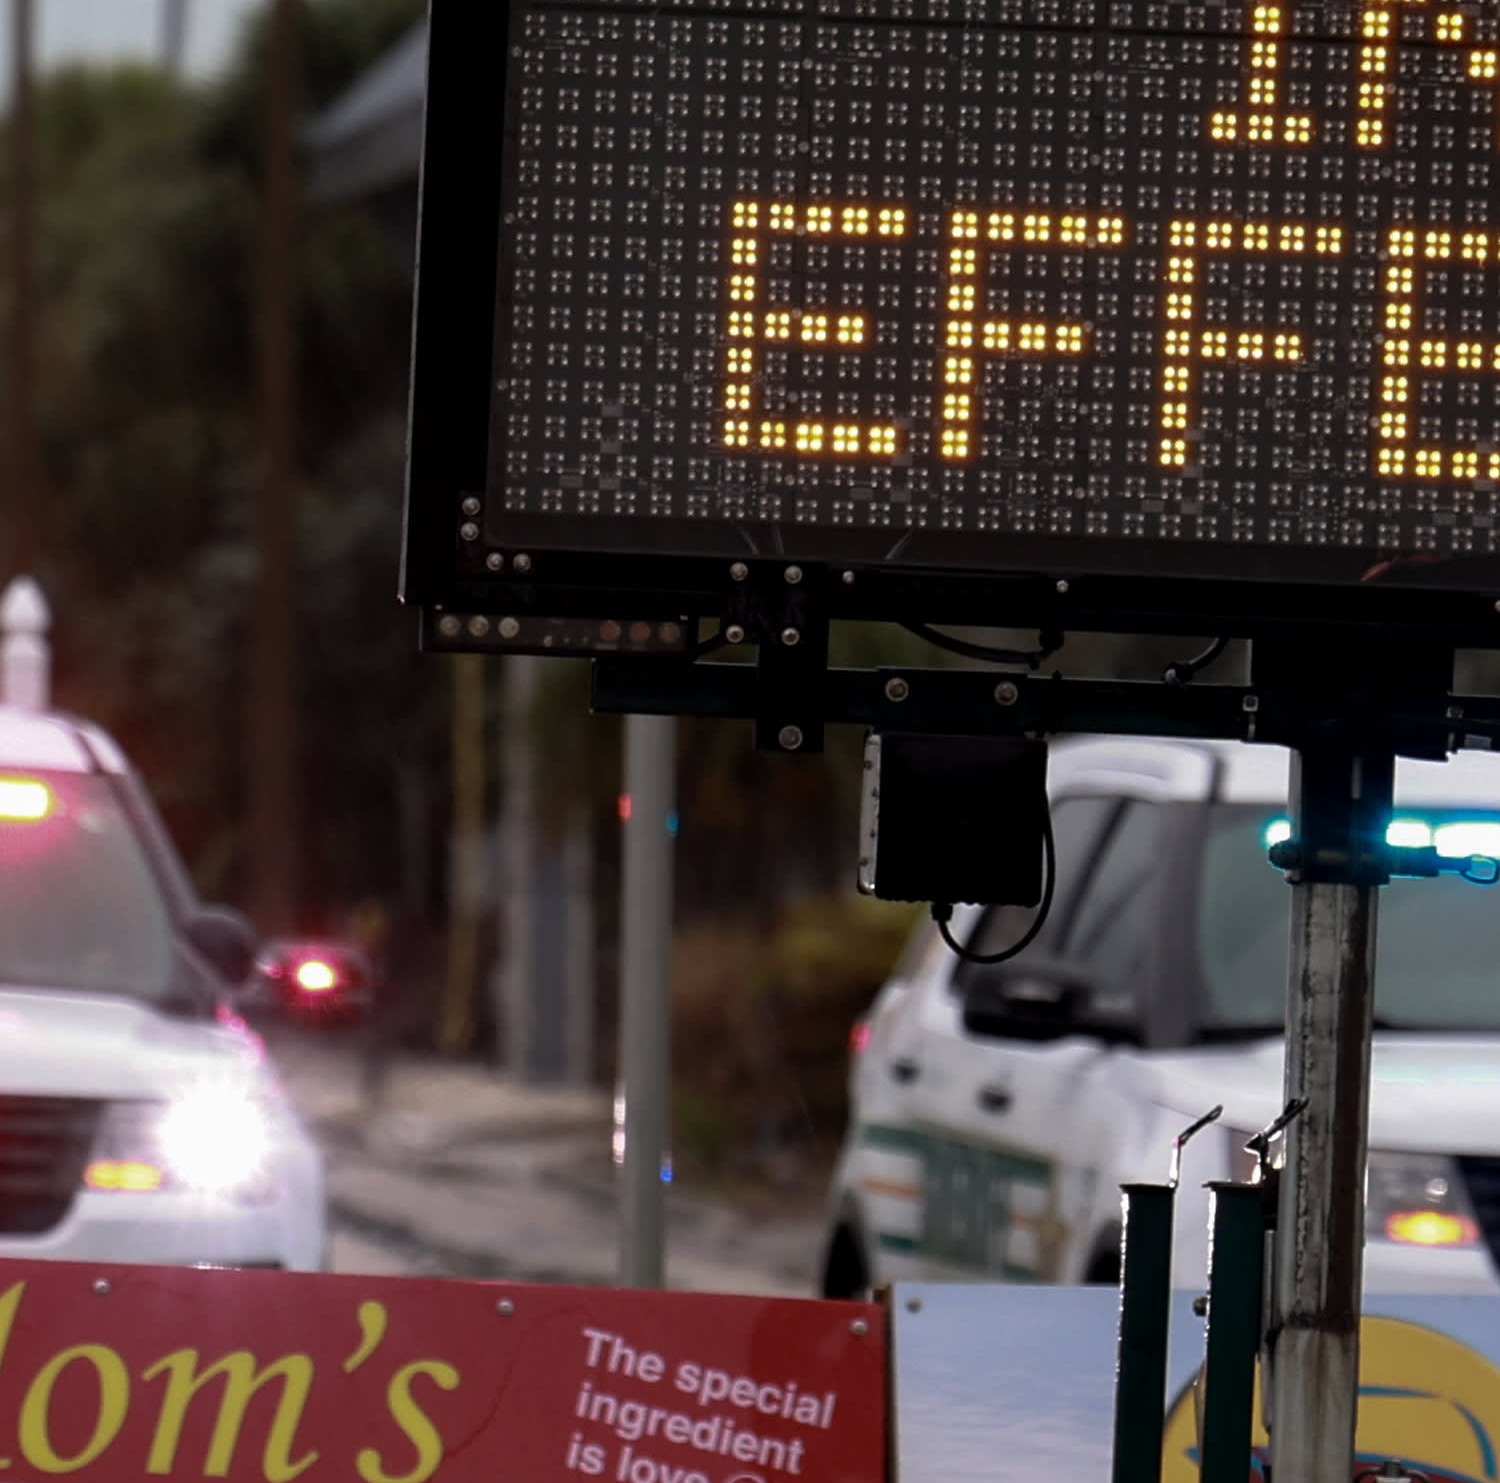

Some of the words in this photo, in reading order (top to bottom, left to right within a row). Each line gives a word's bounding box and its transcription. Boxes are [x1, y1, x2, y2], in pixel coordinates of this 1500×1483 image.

[583, 1327, 665, 1385] The
[674, 1359, 836, 1429] special
[567, 1436, 606, 1477] is
[575, 1382, 804, 1475] ingredient
